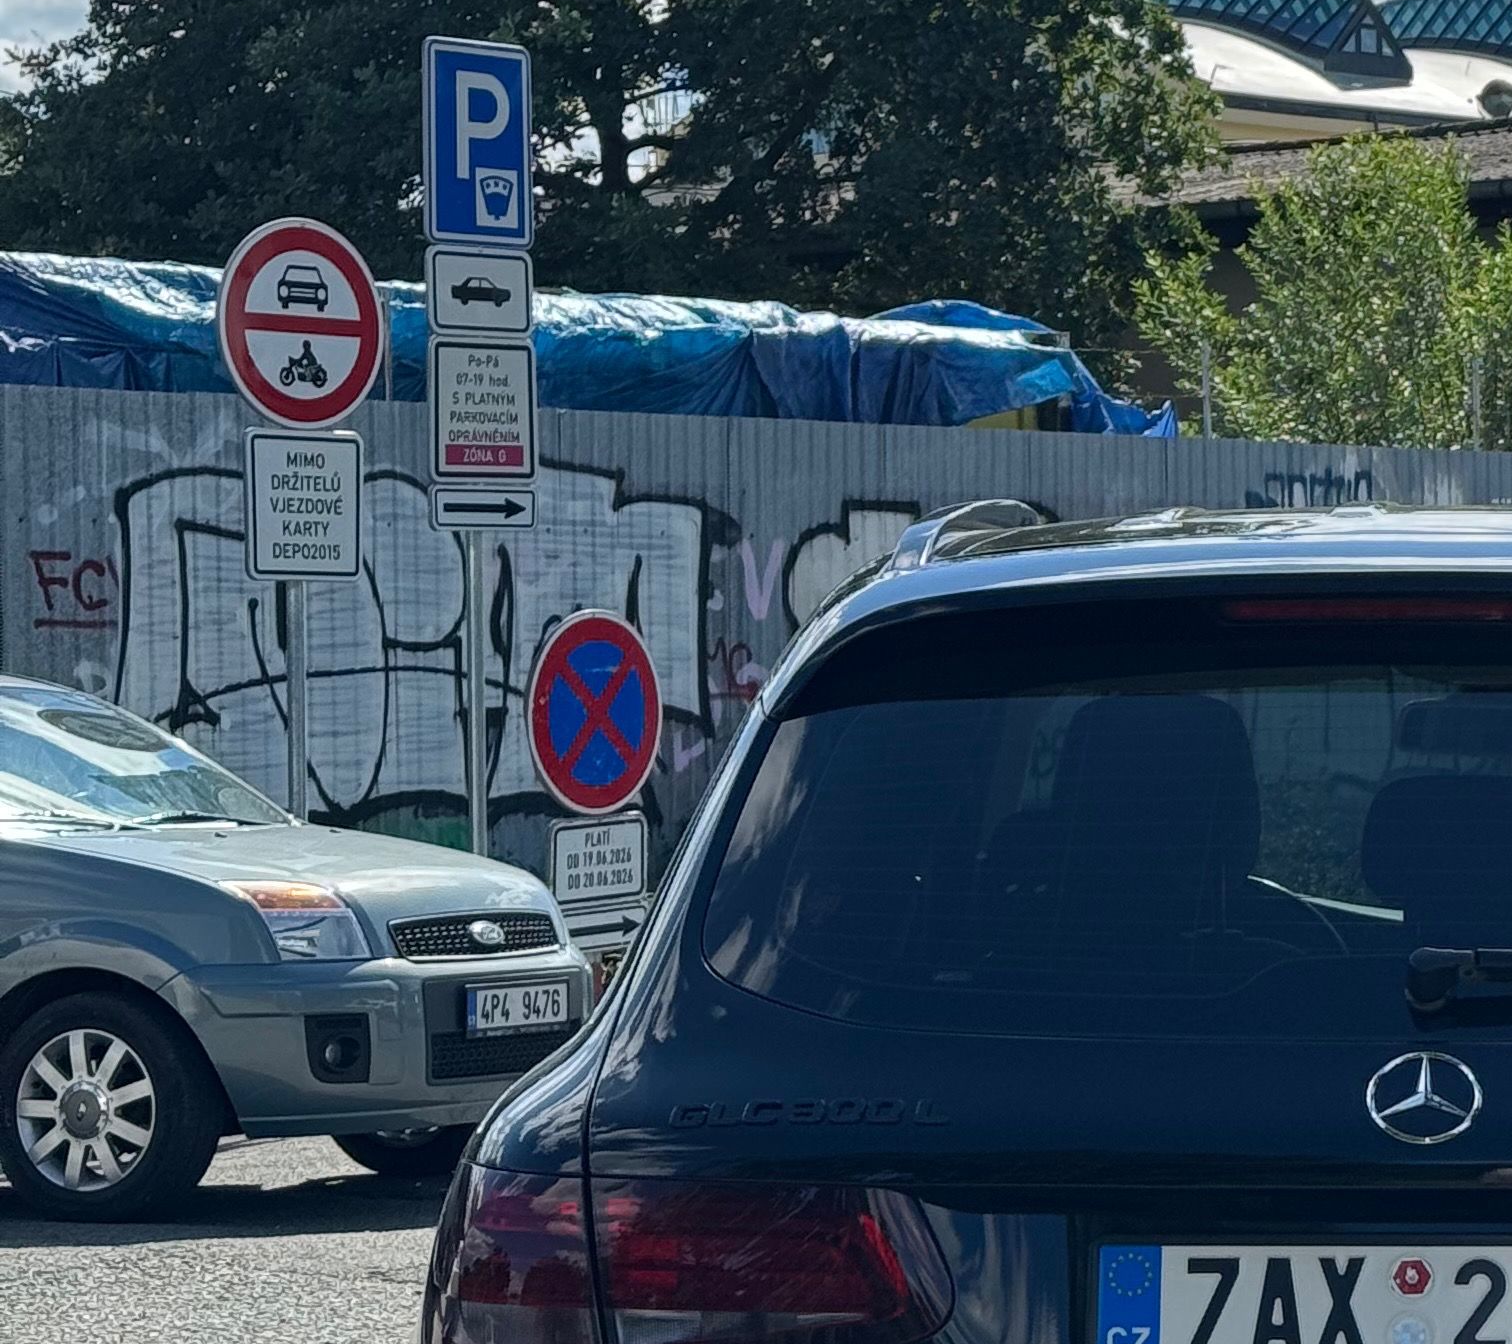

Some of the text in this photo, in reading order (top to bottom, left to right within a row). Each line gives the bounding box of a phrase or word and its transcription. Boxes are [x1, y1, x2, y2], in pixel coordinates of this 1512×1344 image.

[456, 69, 510, 180] P
[452, 389, 516, 407] S PLATNÝM
[449, 408, 519, 426] PARKOVACÍM
[286, 451, 326, 469] MIMO
[463, 446, 494, 463] ZÓNA
[271, 470, 341, 493] DRŽITELŮ
[269, 494, 344, 516] VJEZDOVÉ
[282, 519, 330, 538] KARTY
[272, 542, 341, 561] DEPO2015
[584, 828, 611, 848] PLATÍ
[480, 988, 561, 1025] 4P4 9476
